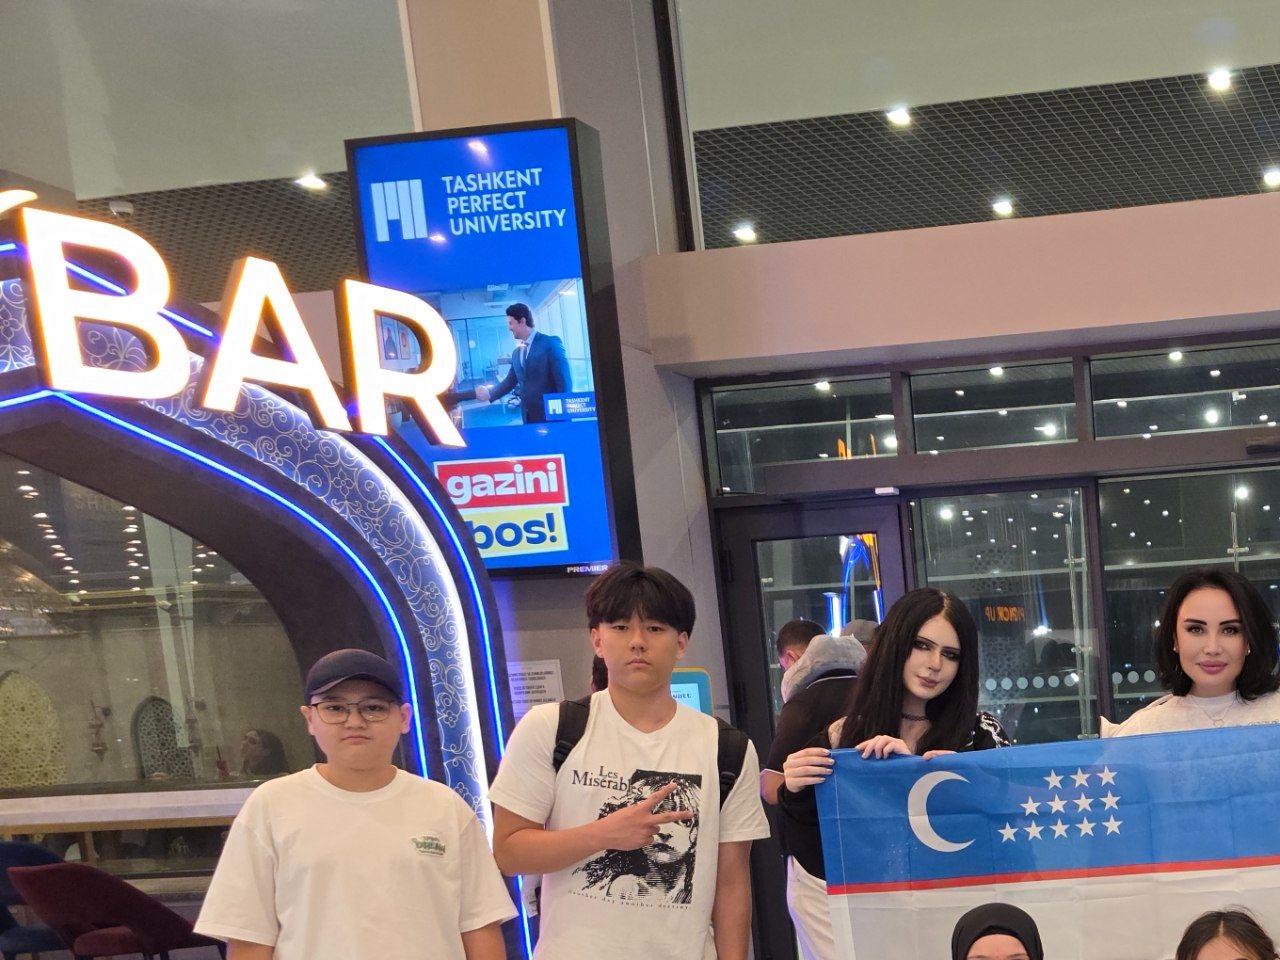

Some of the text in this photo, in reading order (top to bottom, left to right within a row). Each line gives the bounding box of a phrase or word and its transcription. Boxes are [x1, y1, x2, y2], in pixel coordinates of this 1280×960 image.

[441, 167, 543, 194] TASHKENT
[447, 191, 527, 215] PERFECT
[450, 208, 567, 236] UNIVERSITY
[22, 206, 467, 448] BAR
[446, 461, 559, 505] gazini
[466, 512, 558, 549] bos!
[567, 564, 609, 573] PREMIER
[599, 765, 619, 779] Les
